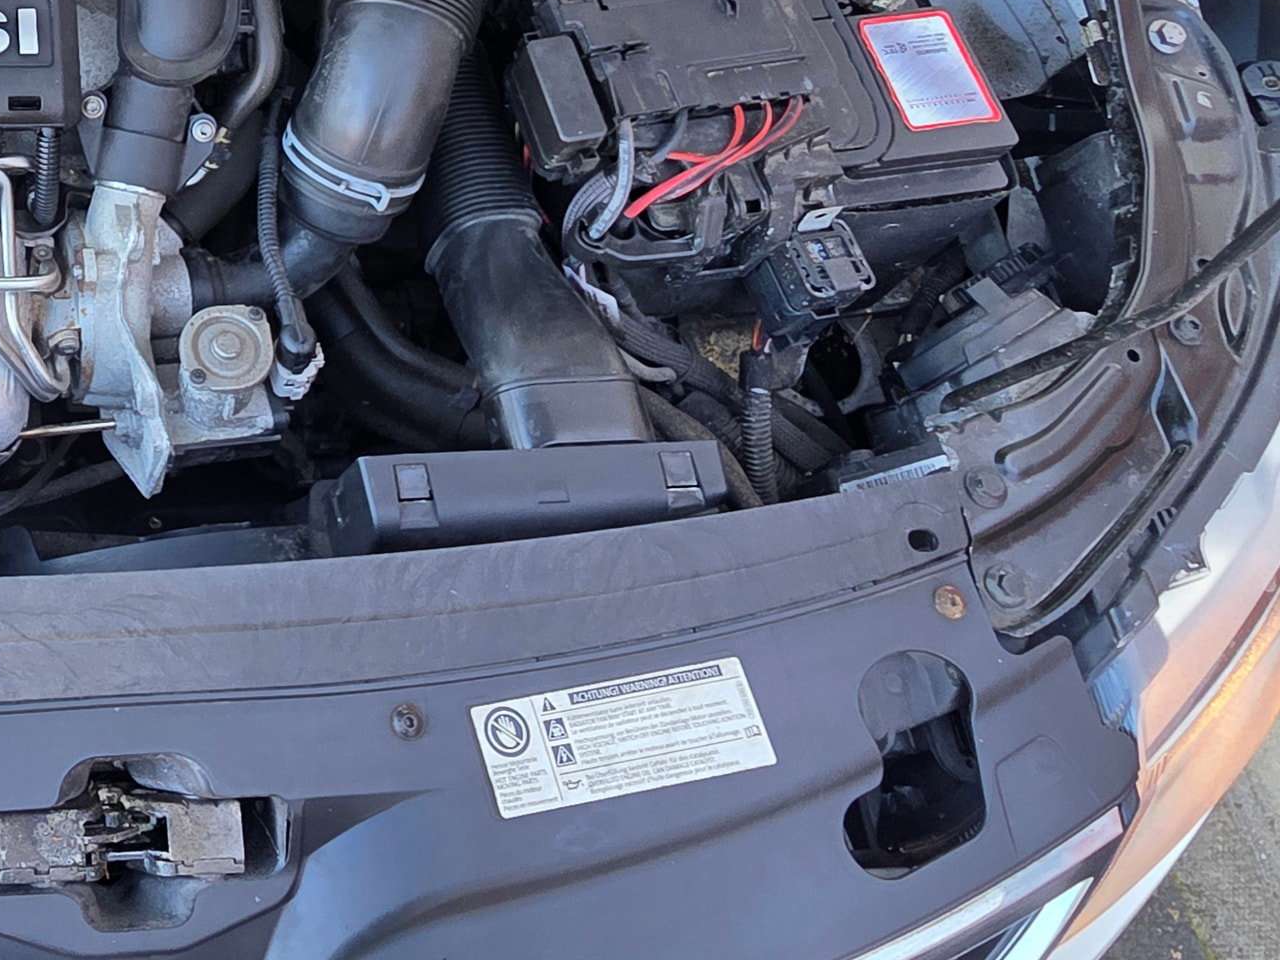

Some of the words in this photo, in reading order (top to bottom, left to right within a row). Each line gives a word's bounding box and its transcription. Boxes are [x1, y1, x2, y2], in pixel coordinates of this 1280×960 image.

[572, 685, 619, 704] ACHTUNG!
[620, 677, 668, 695] WARNING!
[668, 667, 719, 685] ATTENTION!
